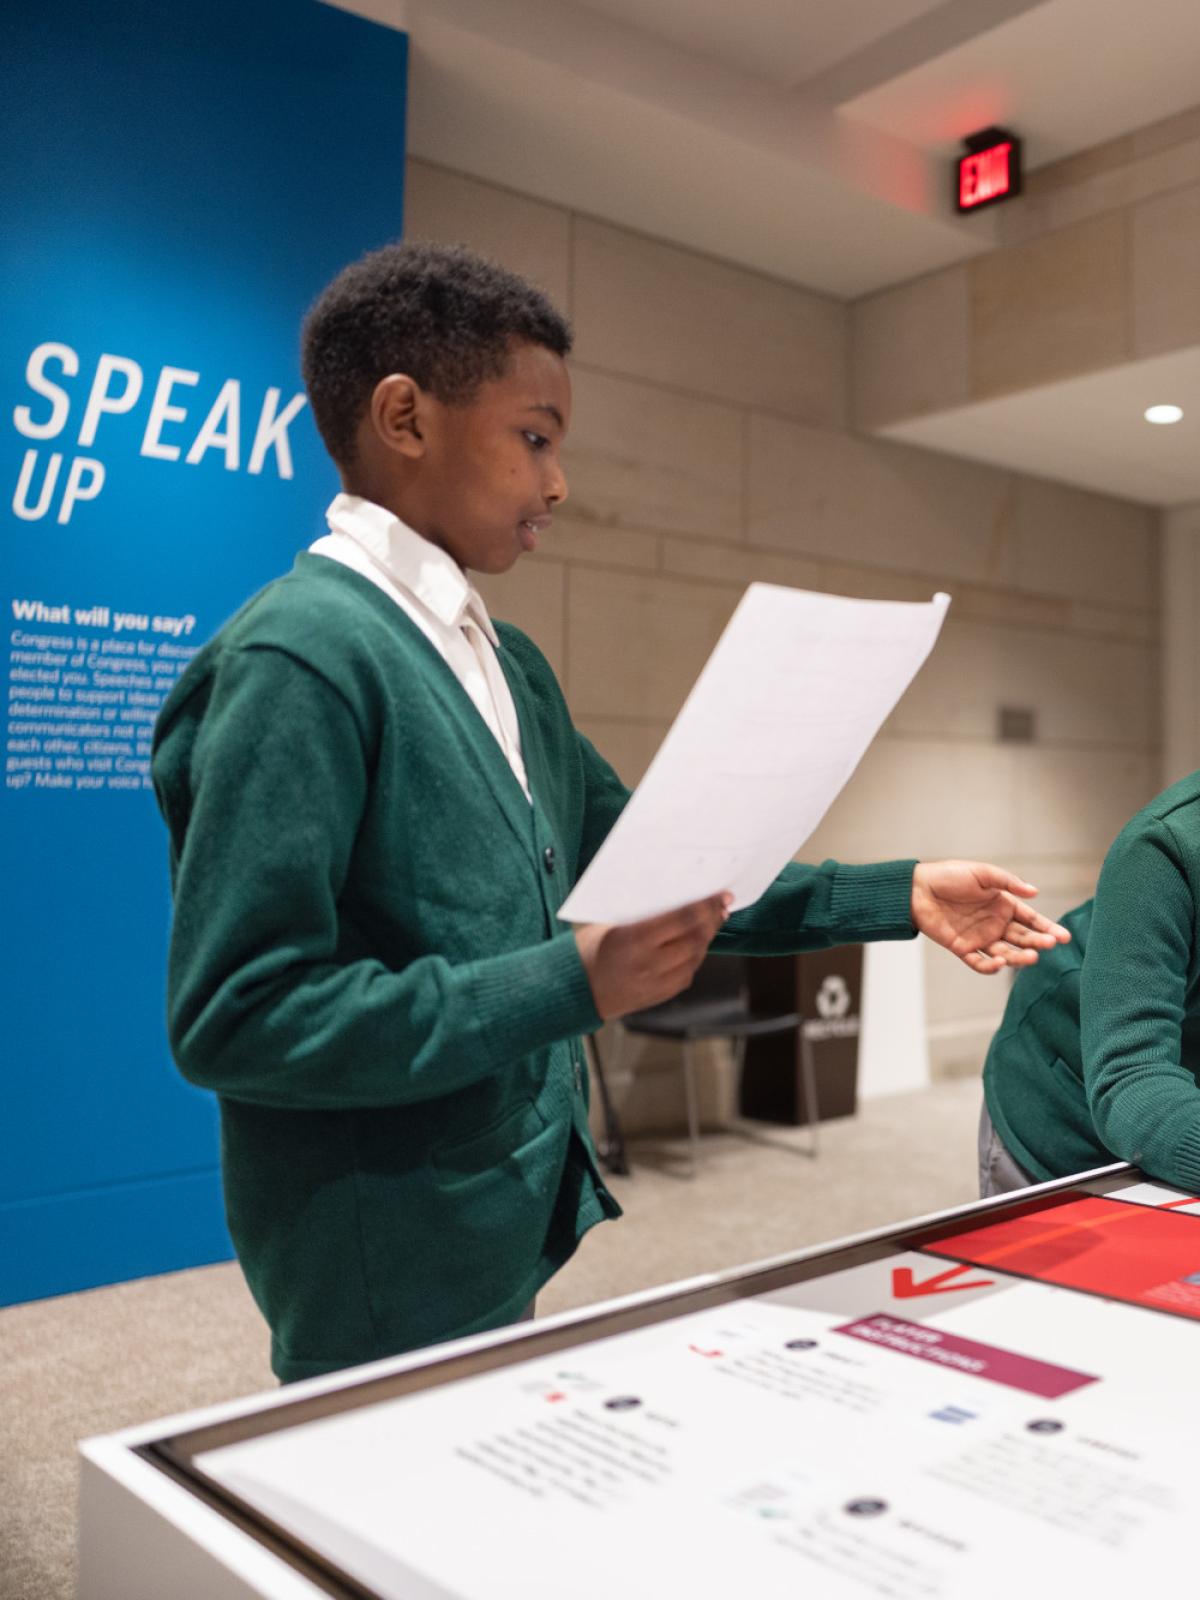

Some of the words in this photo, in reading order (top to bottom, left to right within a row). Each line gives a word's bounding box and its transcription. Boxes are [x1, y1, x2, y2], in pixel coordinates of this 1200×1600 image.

[13, 341, 308, 480] SPEAK
[12, 448, 106, 525] UP
[12, 599, 70, 624] What
[74, 606, 110, 627] will
[113, 612, 149, 632] you
[151, 614, 196, 637] say?
[11, 630, 73, 650] Congress
[77, 635, 88, 651] is
[91, 639, 99, 651] a
[101, 638, 135, 655] place
[137, 639, 156, 656] for
[10, 650, 68, 667] member
[71, 652, 85, 667] of
[151, 660, 174, 675] you
[10, 666, 59, 684] elected
[92, 671, 152, 690] Speeches
[9, 686, 55, 702] people
[58, 687, 73, 702] to
[75, 690, 125, 706] support
[8, 701, 100, 719] determination
[7, 720, 110, 738] communicators
[6, 737, 41, 753] each
[6, 755, 52, 773] guests
[55, 756, 85, 772] who
[86, 756, 113, 772] visit
[34, 772, 73, 788] Make
[75, 775, 105, 791] your
[107, 775, 141, 790] voice
